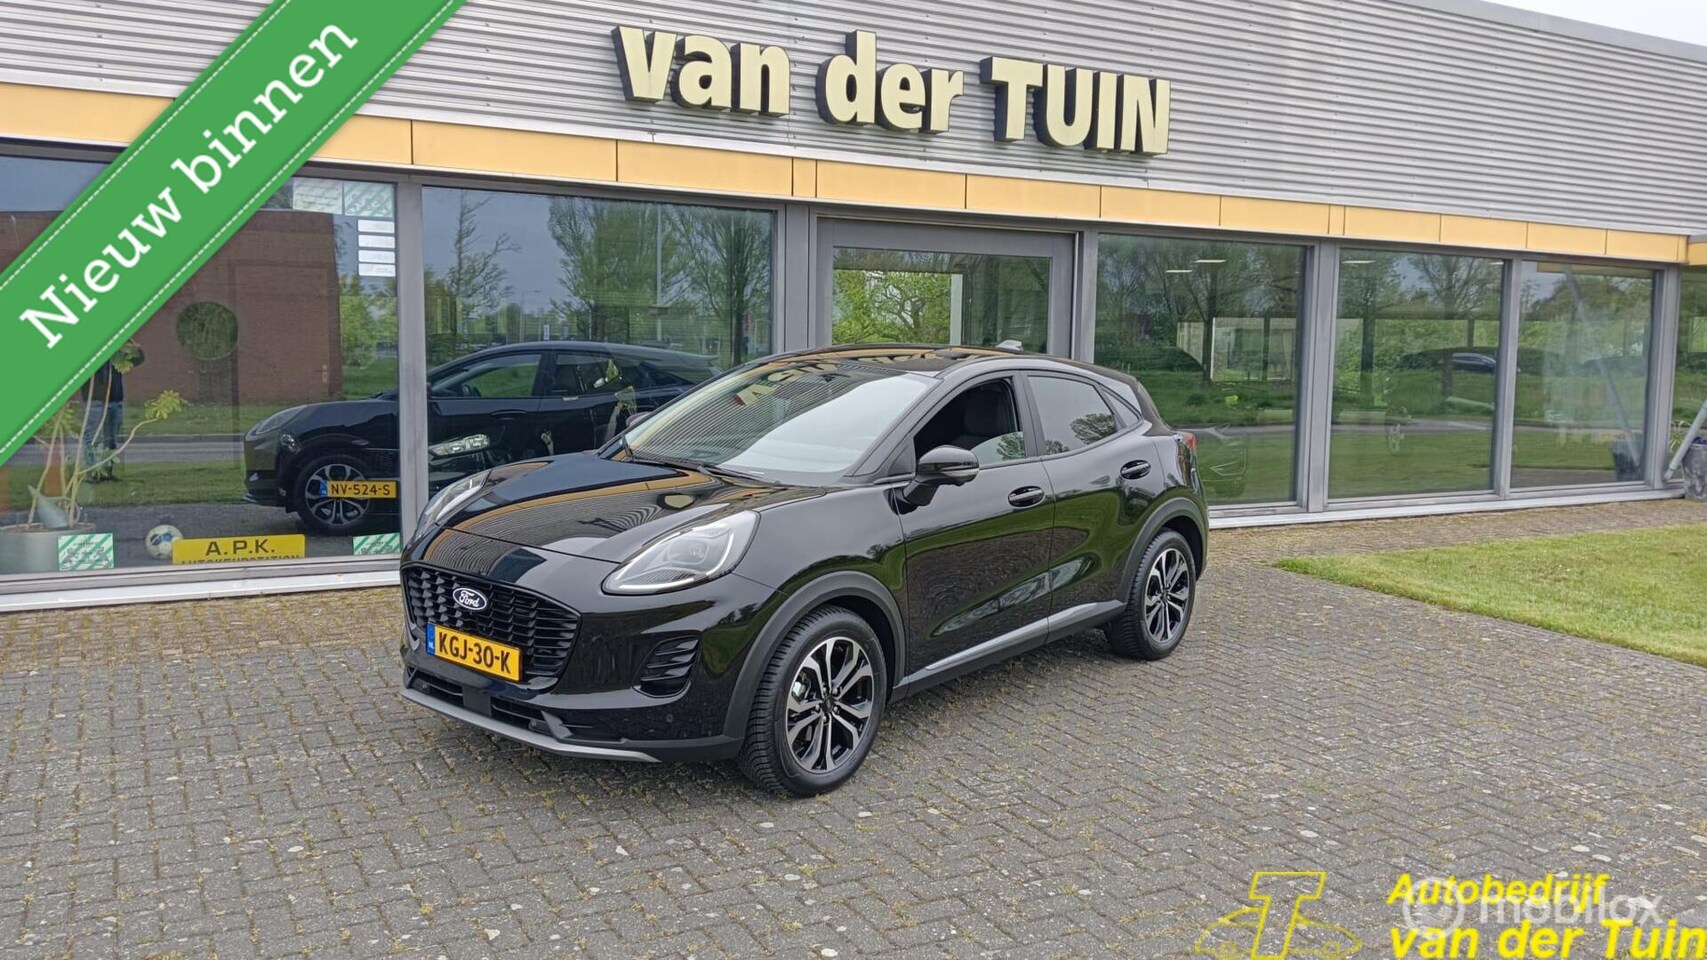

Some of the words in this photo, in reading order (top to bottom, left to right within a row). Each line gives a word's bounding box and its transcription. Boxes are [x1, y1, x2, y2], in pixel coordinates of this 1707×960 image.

[612, 26, 791, 116] van
[817, 30, 965, 134] der
[980, 56, 1170, 154] TUIN
[331, 484, 390, 495] NV-524-S
[205, 539, 275, 556] A.P.K.
[458, 589, 481, 608] Ford
[439, 631, 511, 674] KGJ-30-K
